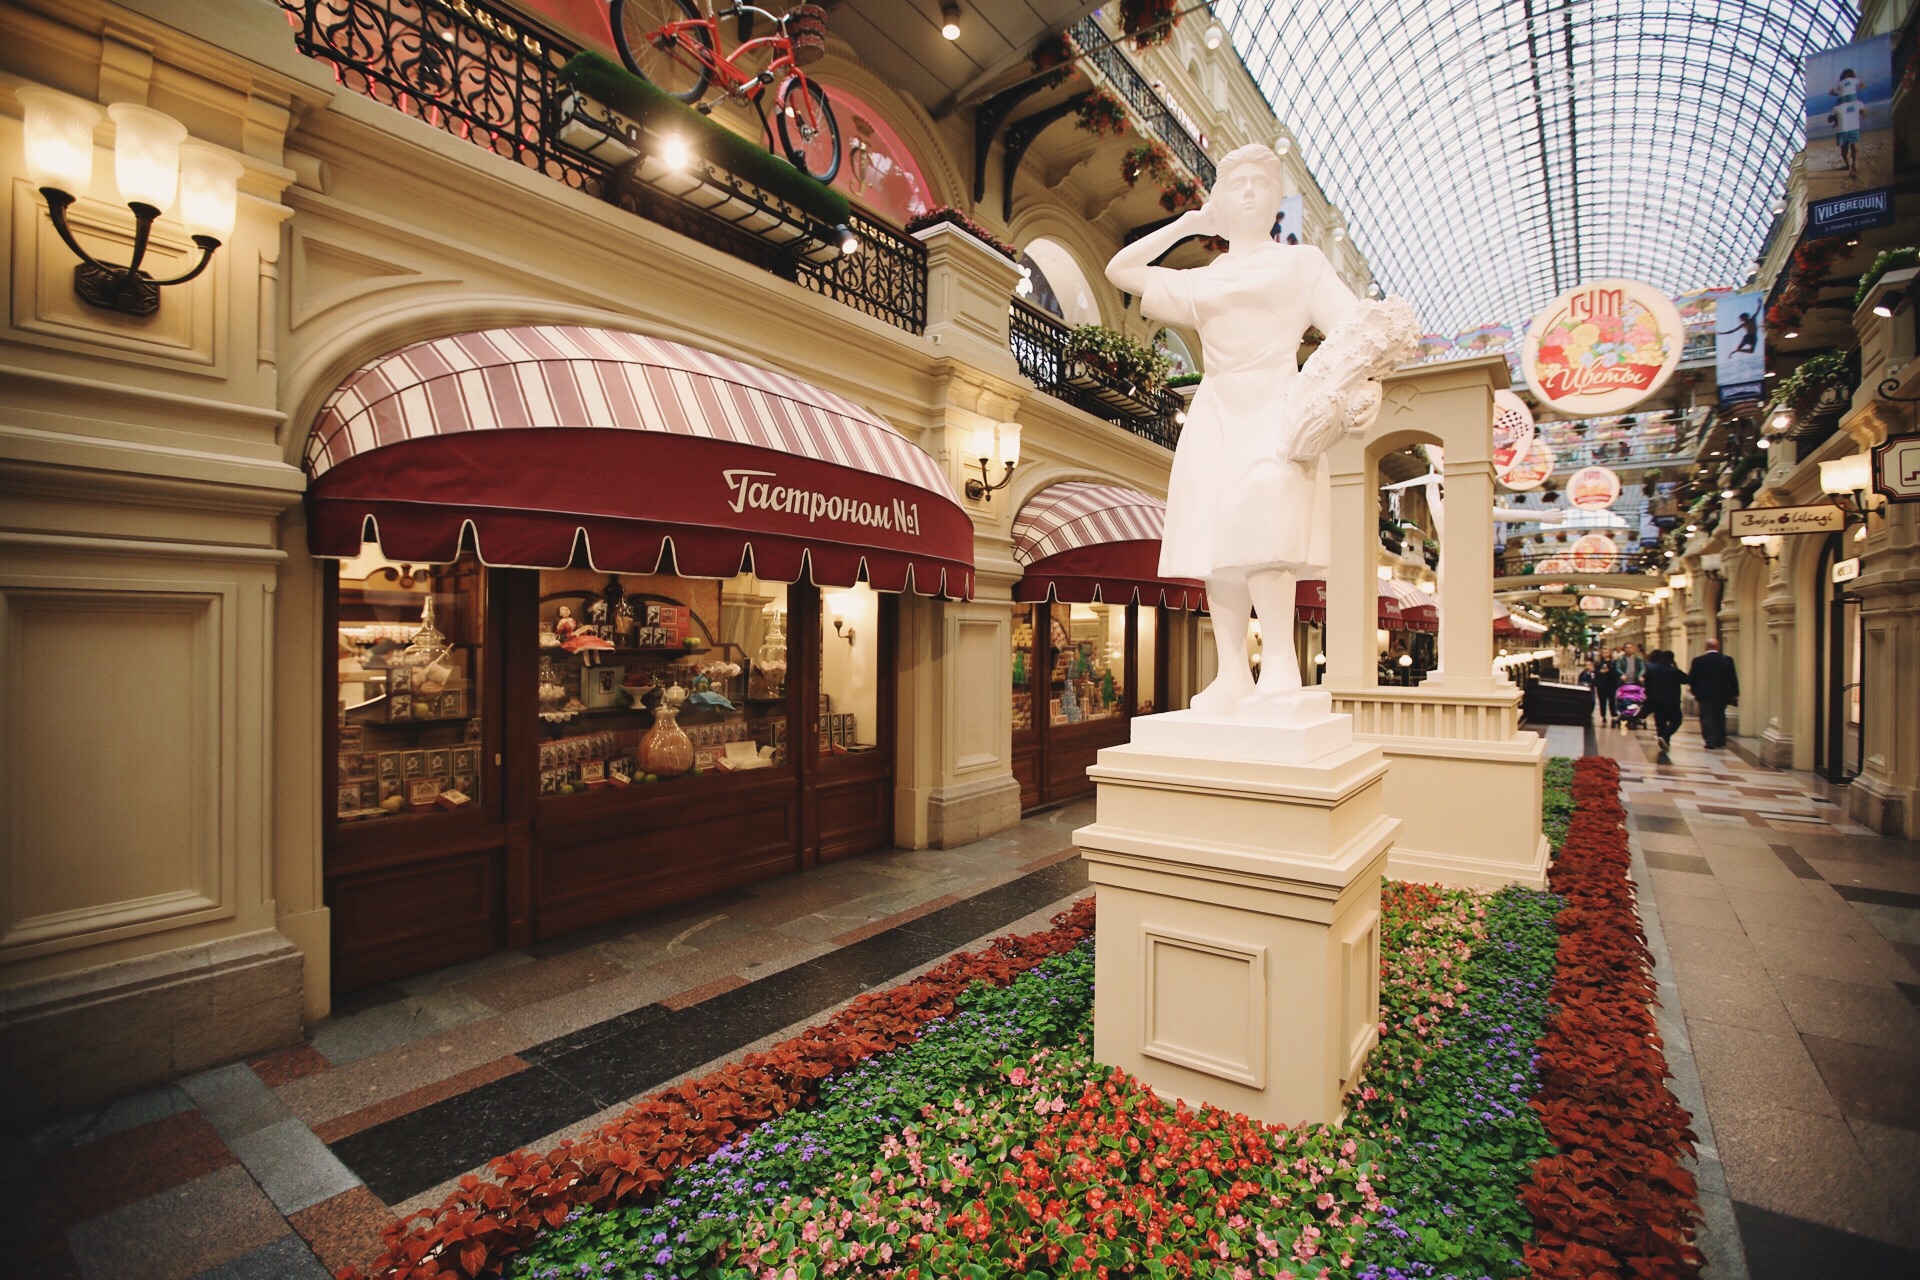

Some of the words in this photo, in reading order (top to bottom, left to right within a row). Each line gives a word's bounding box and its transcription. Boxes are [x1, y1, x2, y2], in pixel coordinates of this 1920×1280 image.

[1818, 195, 1883, 221] VILEBREQUIN
[1570, 288, 1622, 320] ГУМ
[1545, 356, 1647, 396] Цветы
[722, 469, 892, 530] Гастроном
[892, 498, 920, 536] №1
